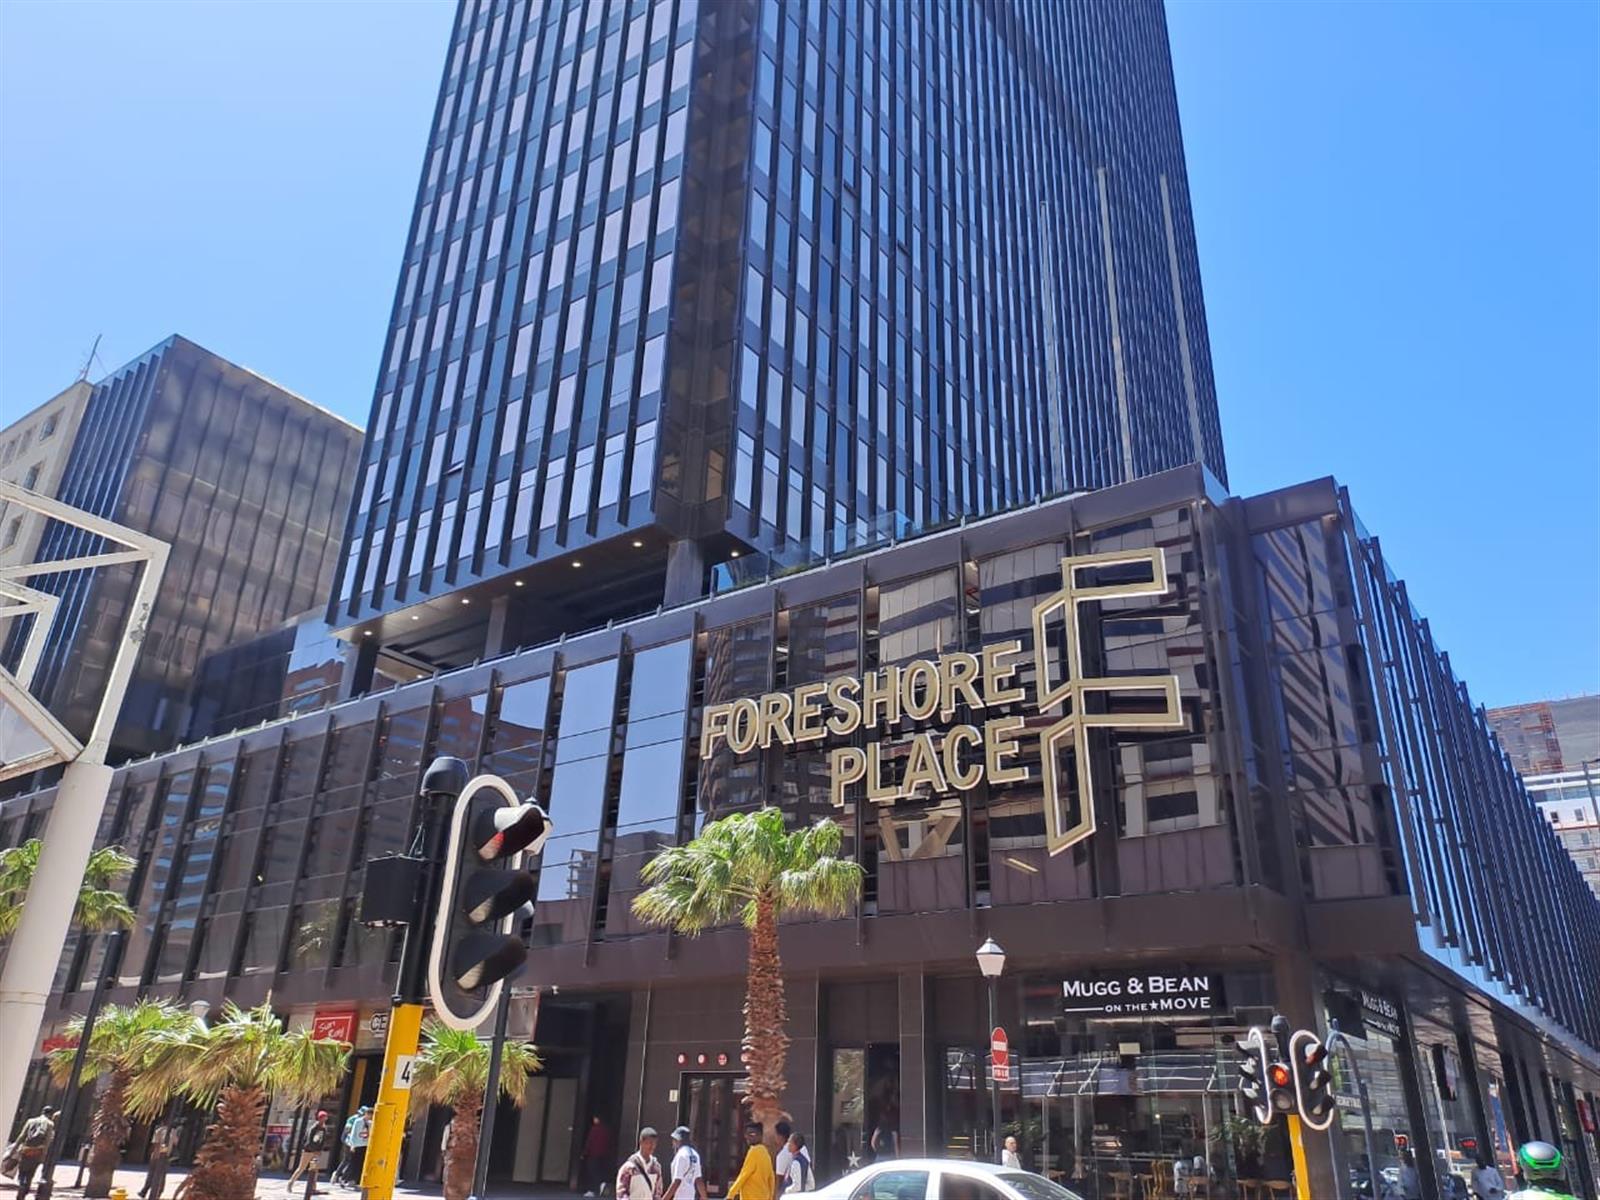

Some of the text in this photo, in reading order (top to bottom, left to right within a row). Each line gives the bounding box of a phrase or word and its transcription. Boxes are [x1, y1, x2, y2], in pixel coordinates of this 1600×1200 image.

[699, 639, 1026, 761] FORESHORE
[830, 714, 1031, 808] PLACE
[1062, 976, 1209, 998] MUGG & BEAN
[1105, 997, 1211, 1013] ON THE MOVE
[401, 1061, 411, 1084] 4
